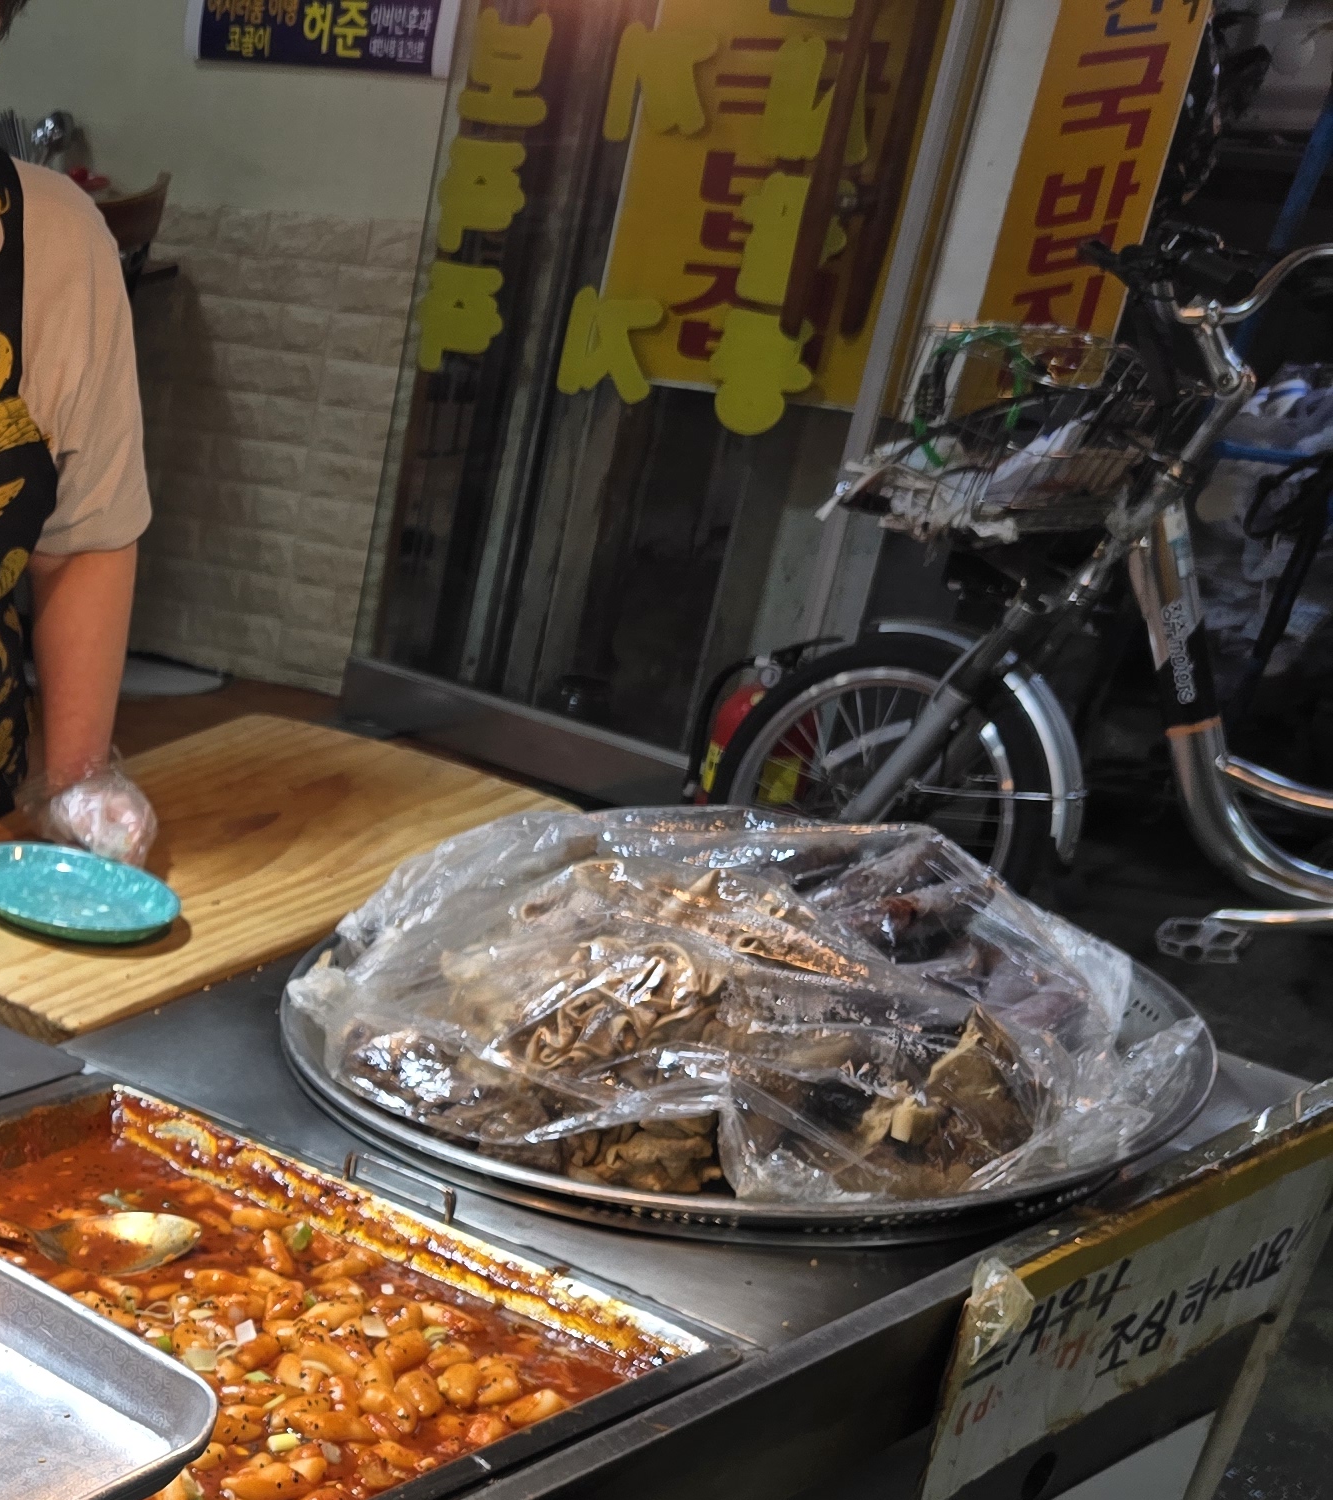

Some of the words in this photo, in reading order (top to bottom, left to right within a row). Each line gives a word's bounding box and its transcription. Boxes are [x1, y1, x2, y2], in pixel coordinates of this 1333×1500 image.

[303, 2, 369, 58] 허준
[370, 4, 432, 37] 이비인후과
[225, 25, 272, 58] 코골이
